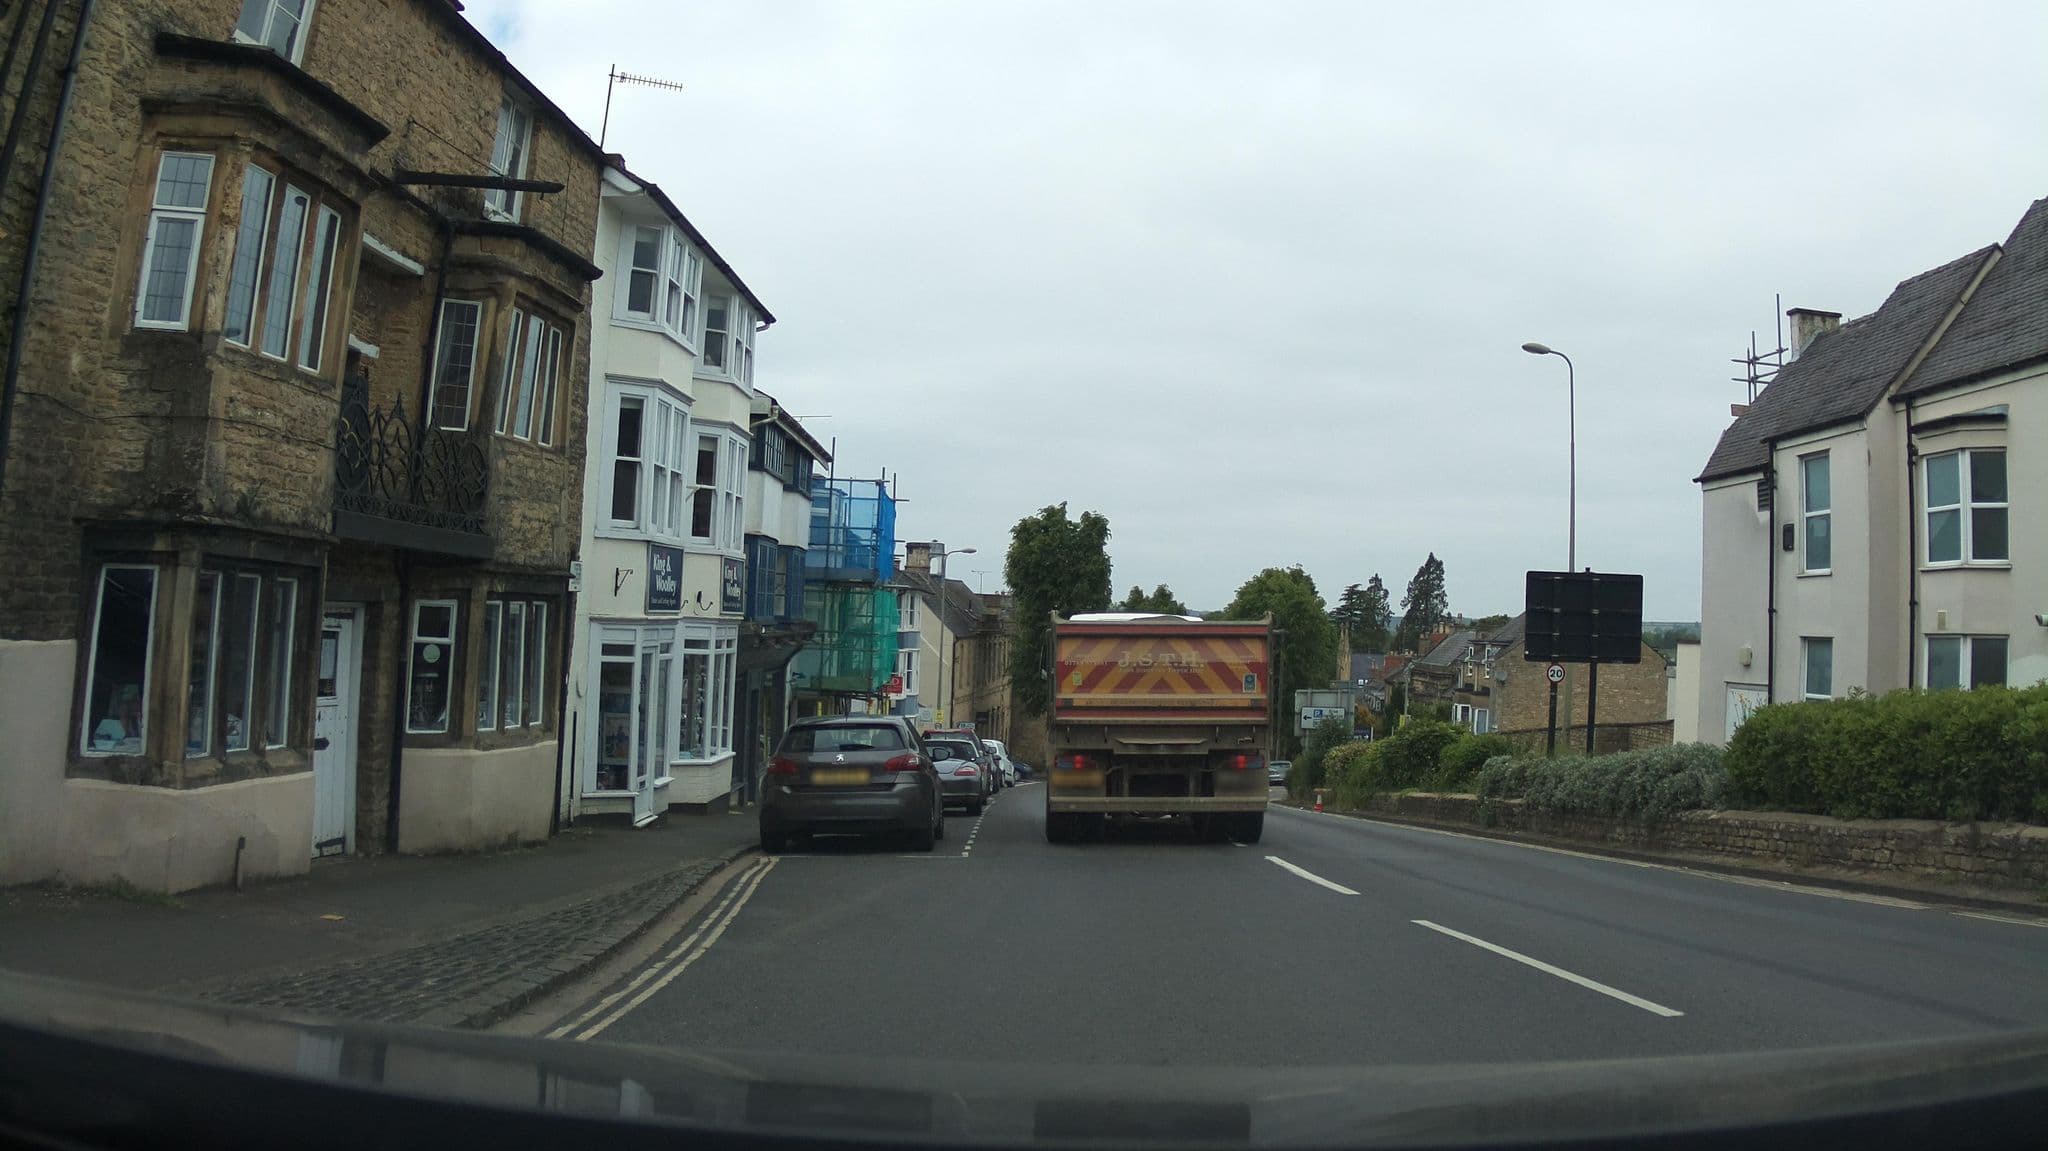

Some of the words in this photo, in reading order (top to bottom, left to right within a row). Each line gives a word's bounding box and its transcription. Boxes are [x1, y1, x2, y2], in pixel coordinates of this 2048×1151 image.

[653, 553, 666, 576] King
[666, 555, 672, 572] &
[656, 574, 676, 597] Woolley
[1549, 669, 1563, 678] 20
